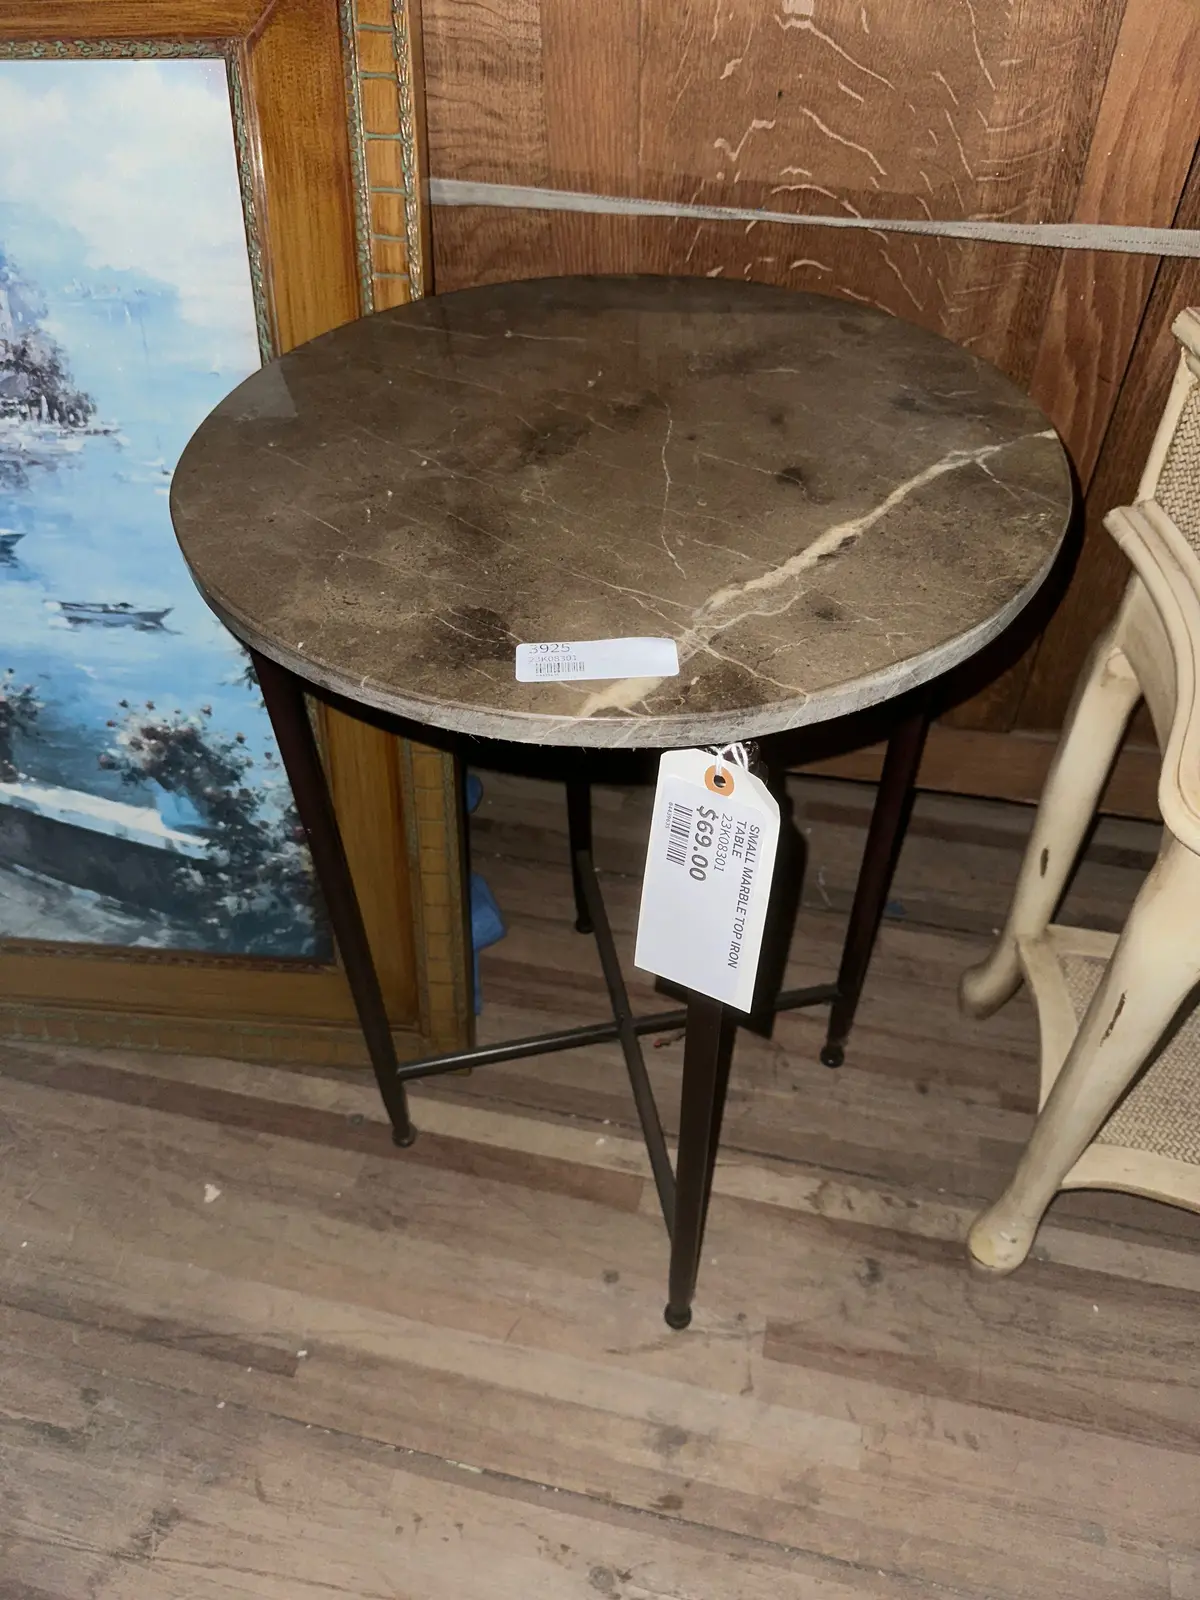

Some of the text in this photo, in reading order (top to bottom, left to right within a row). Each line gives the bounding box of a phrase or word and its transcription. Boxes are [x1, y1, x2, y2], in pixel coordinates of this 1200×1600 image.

[529, 643, 570, 654] 3925
[689, 805, 719, 882] $69.00
[713, 813, 733, 872] 23K08301
[732, 821, 747, 859] TABLE
[727, 824, 760, 969] SMALL MARBLE TOP IRON
